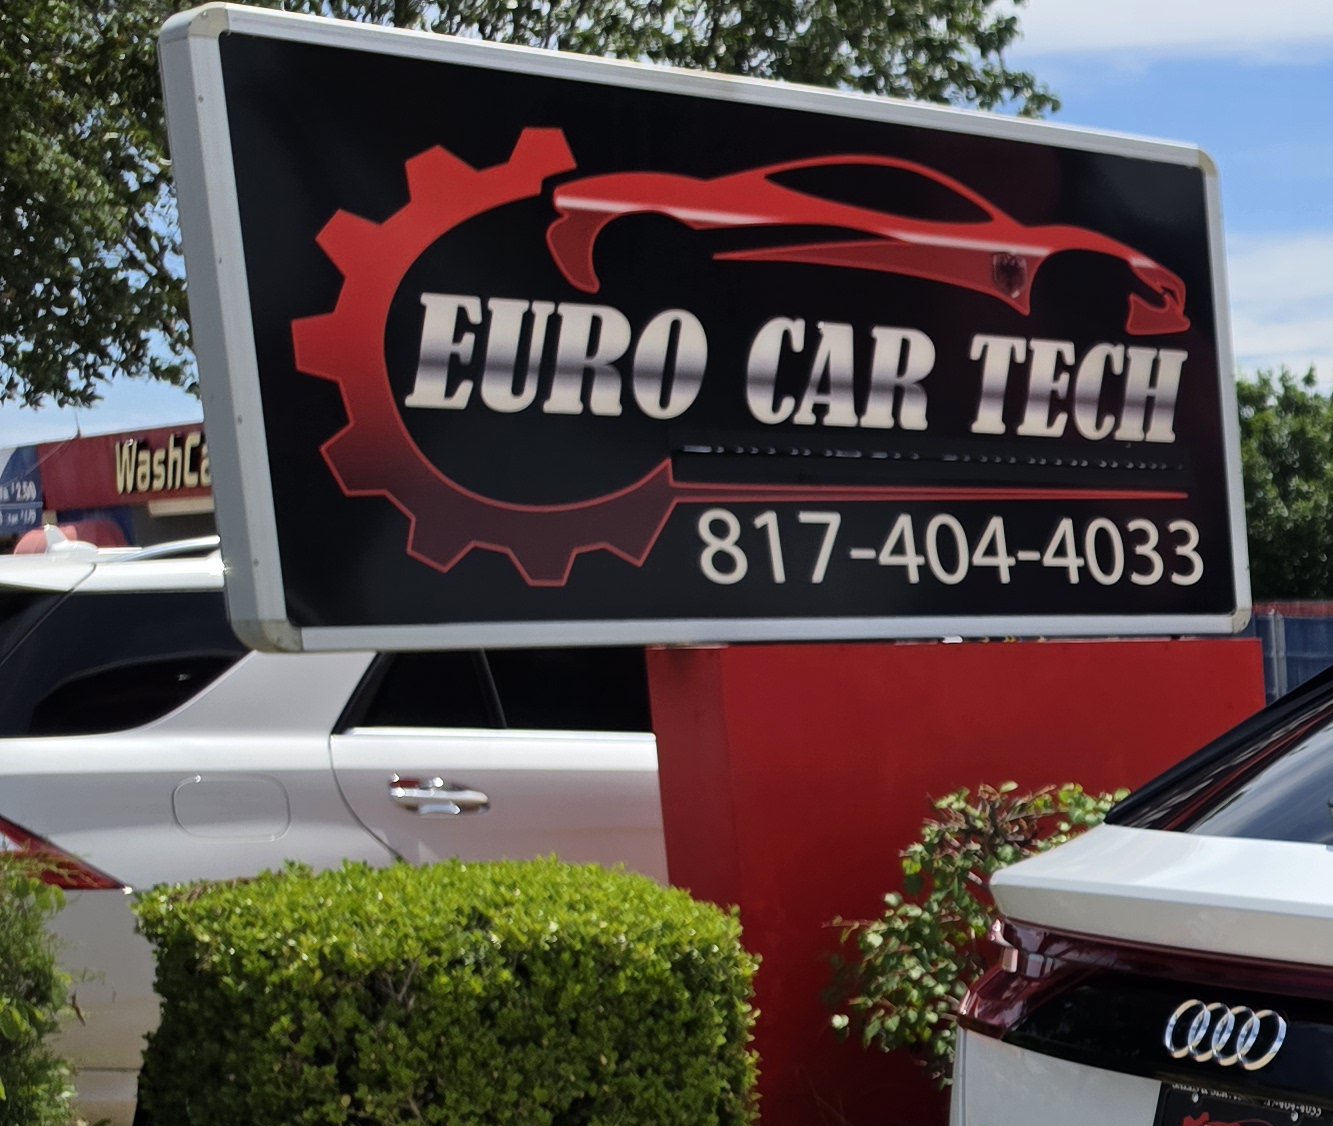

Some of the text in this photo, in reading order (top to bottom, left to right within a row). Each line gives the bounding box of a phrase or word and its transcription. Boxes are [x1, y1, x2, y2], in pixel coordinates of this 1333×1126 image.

[404, 292, 1189, 443] EURO CAR TECH
[698, 508, 1204, 585] 817-404-4033
